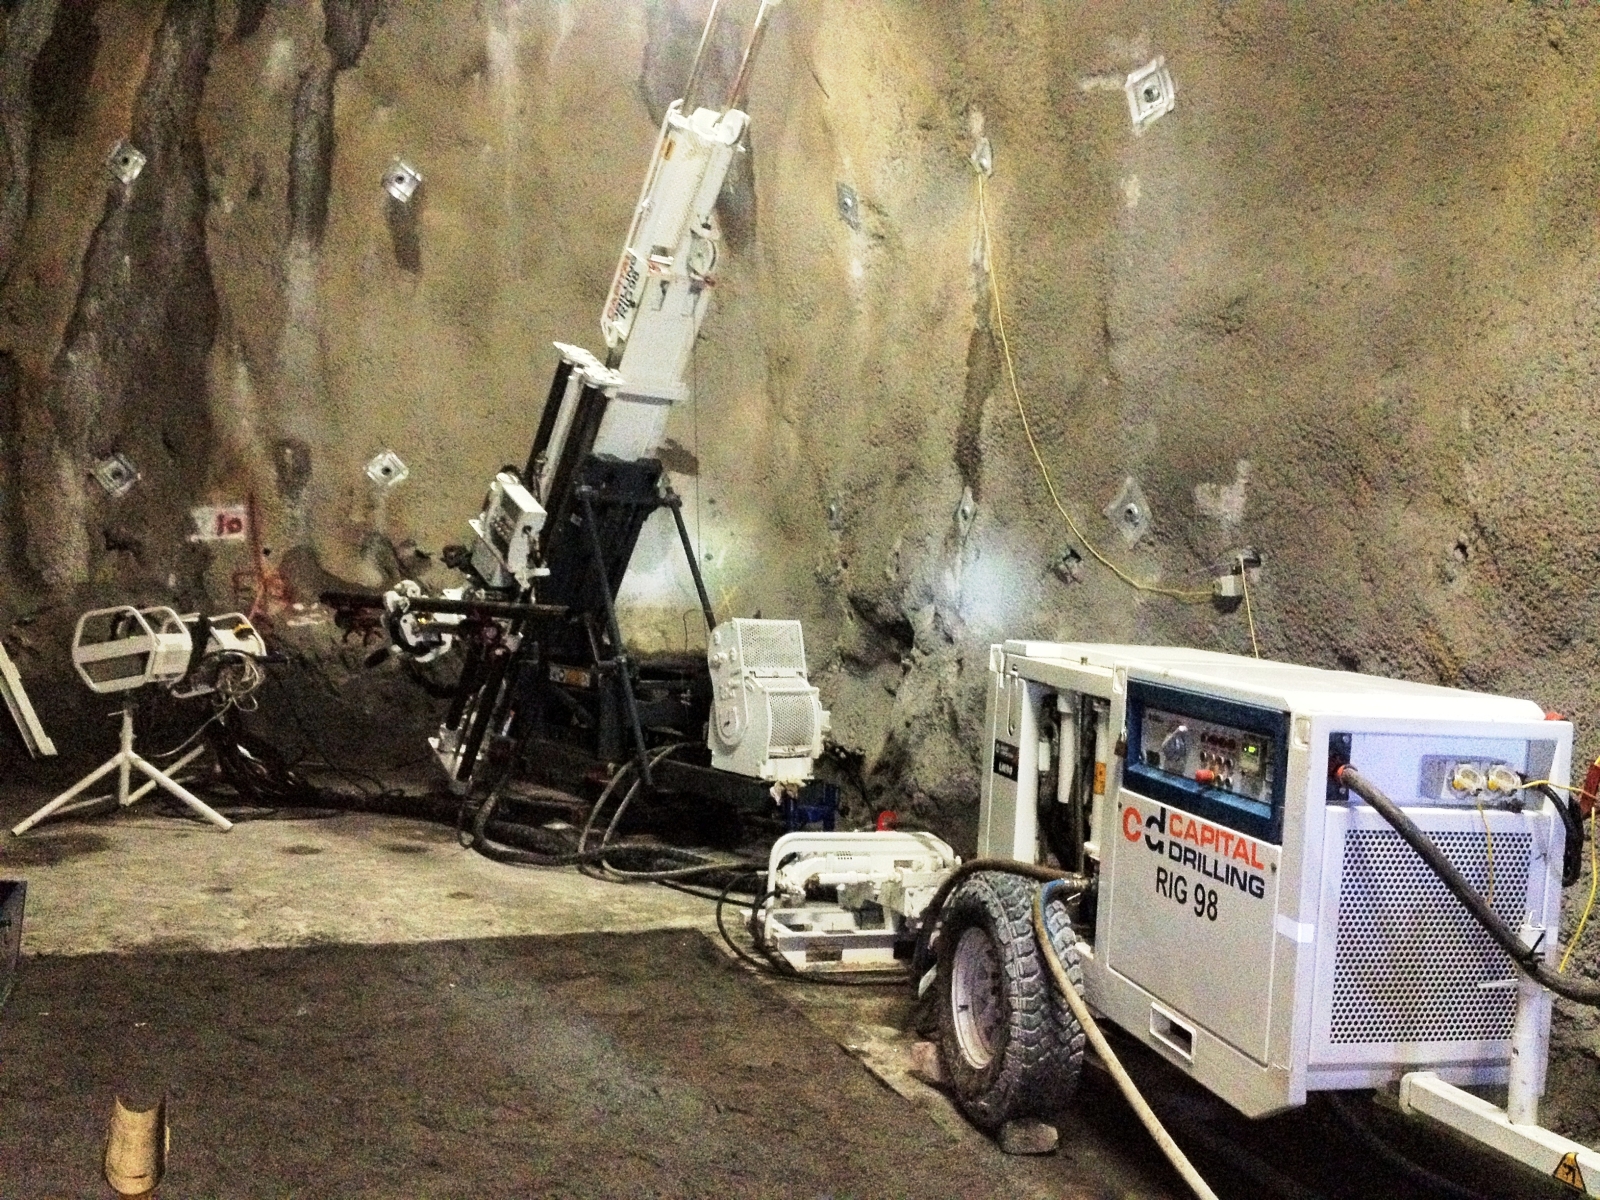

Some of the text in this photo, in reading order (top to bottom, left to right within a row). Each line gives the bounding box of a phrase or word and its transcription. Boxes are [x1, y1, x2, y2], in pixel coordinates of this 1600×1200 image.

[1169, 813, 1264, 870] CAPITAL
[1169, 840, 1265, 899] DRILLING
[1156, 866, 1218, 922] RIG 98
